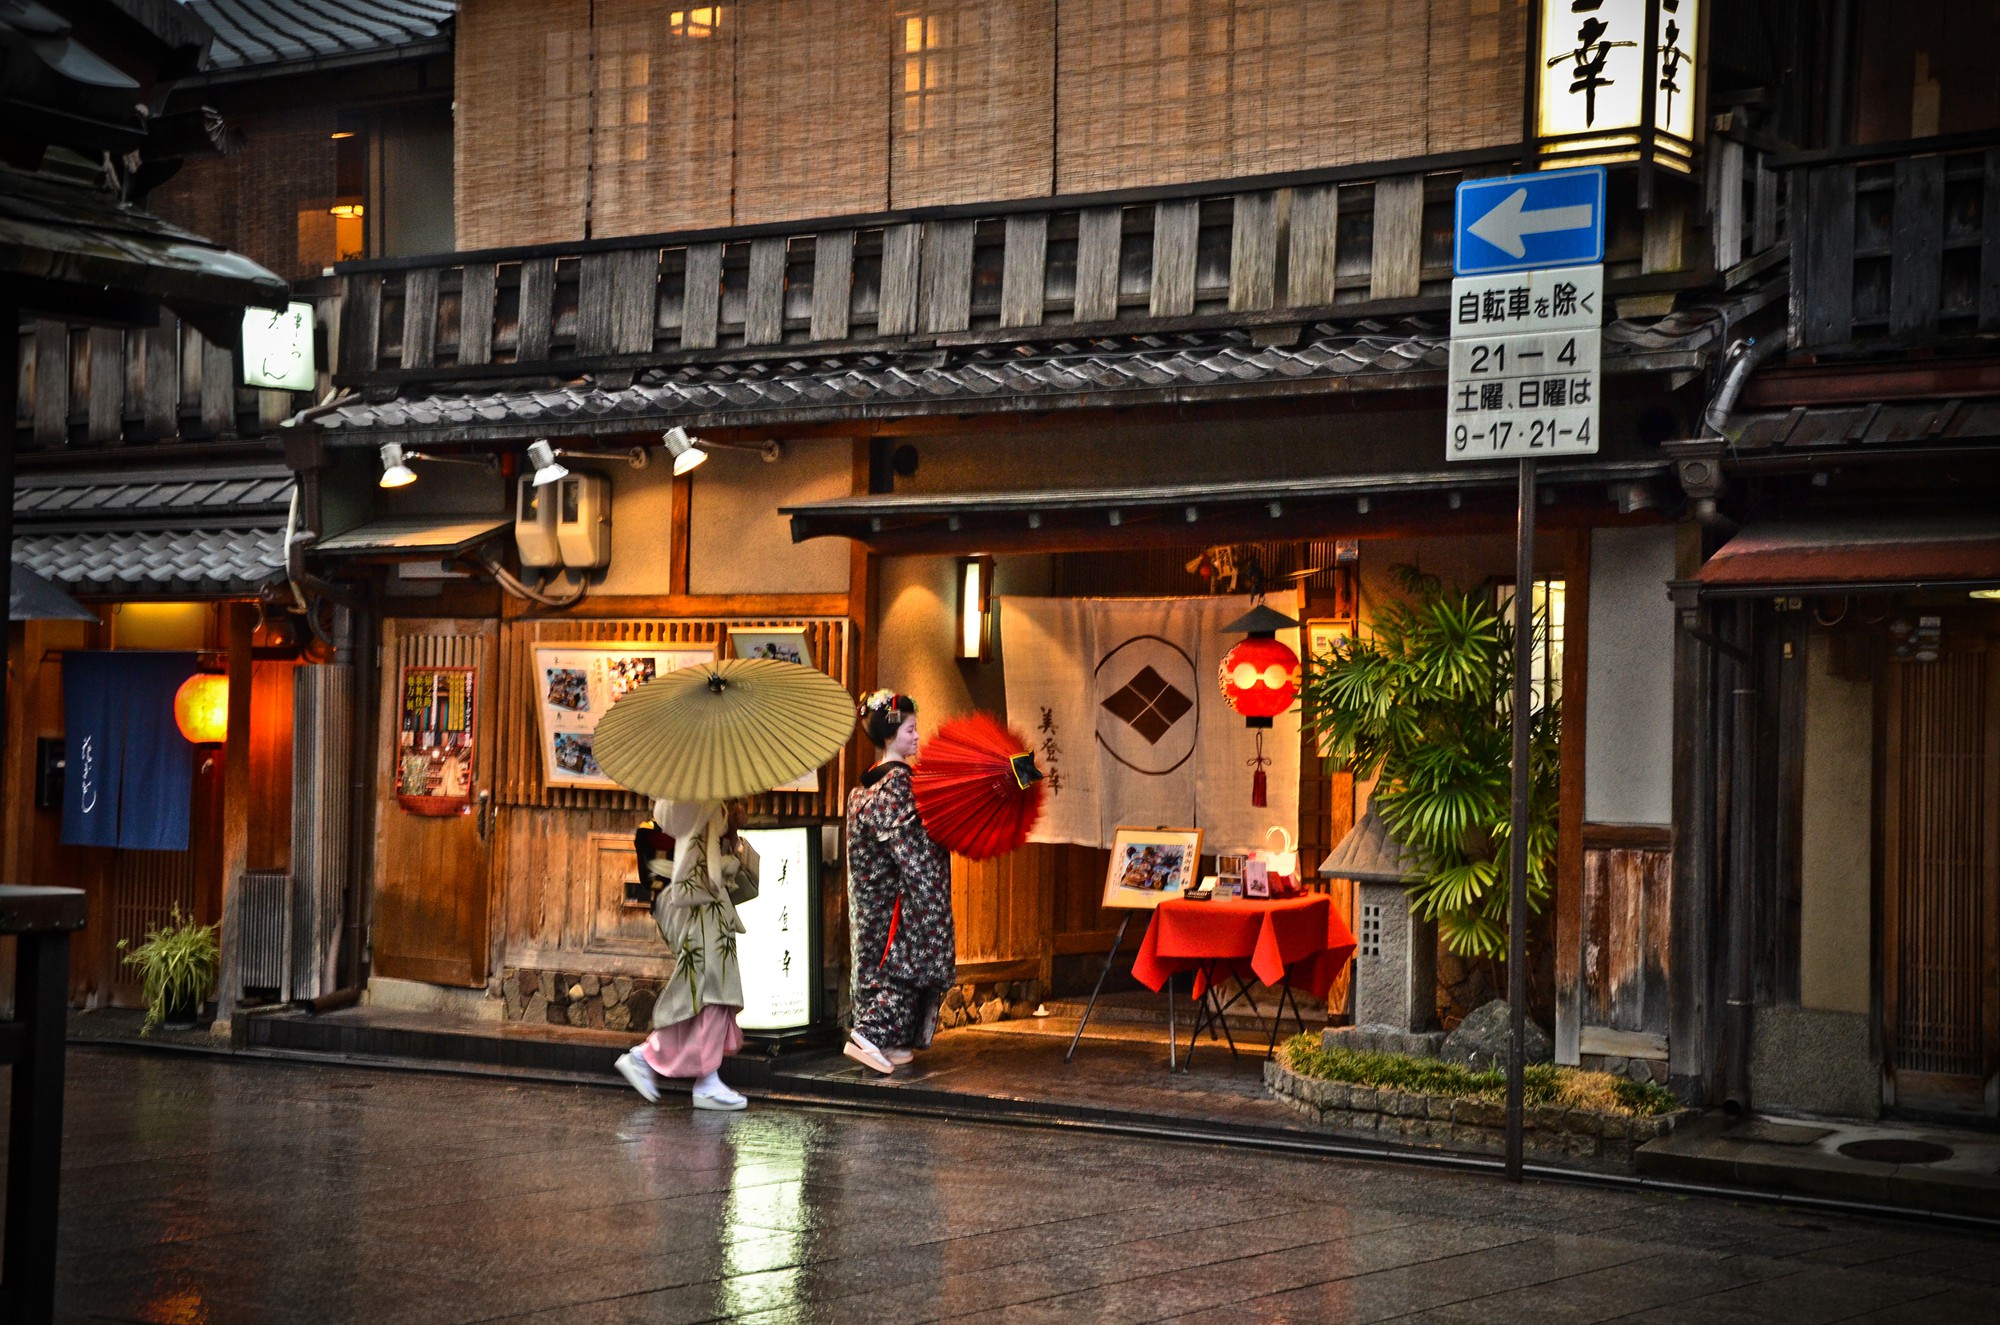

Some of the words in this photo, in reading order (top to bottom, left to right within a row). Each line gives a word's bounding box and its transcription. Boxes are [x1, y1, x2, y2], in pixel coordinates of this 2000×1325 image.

[1547, 0, 1637, 129] 幸
[1458, 282, 1595, 324] 自転車を除く
[1455, 378, 1592, 412] 土曜、日曜は
[1037, 706, 1064, 797] 美登幸
